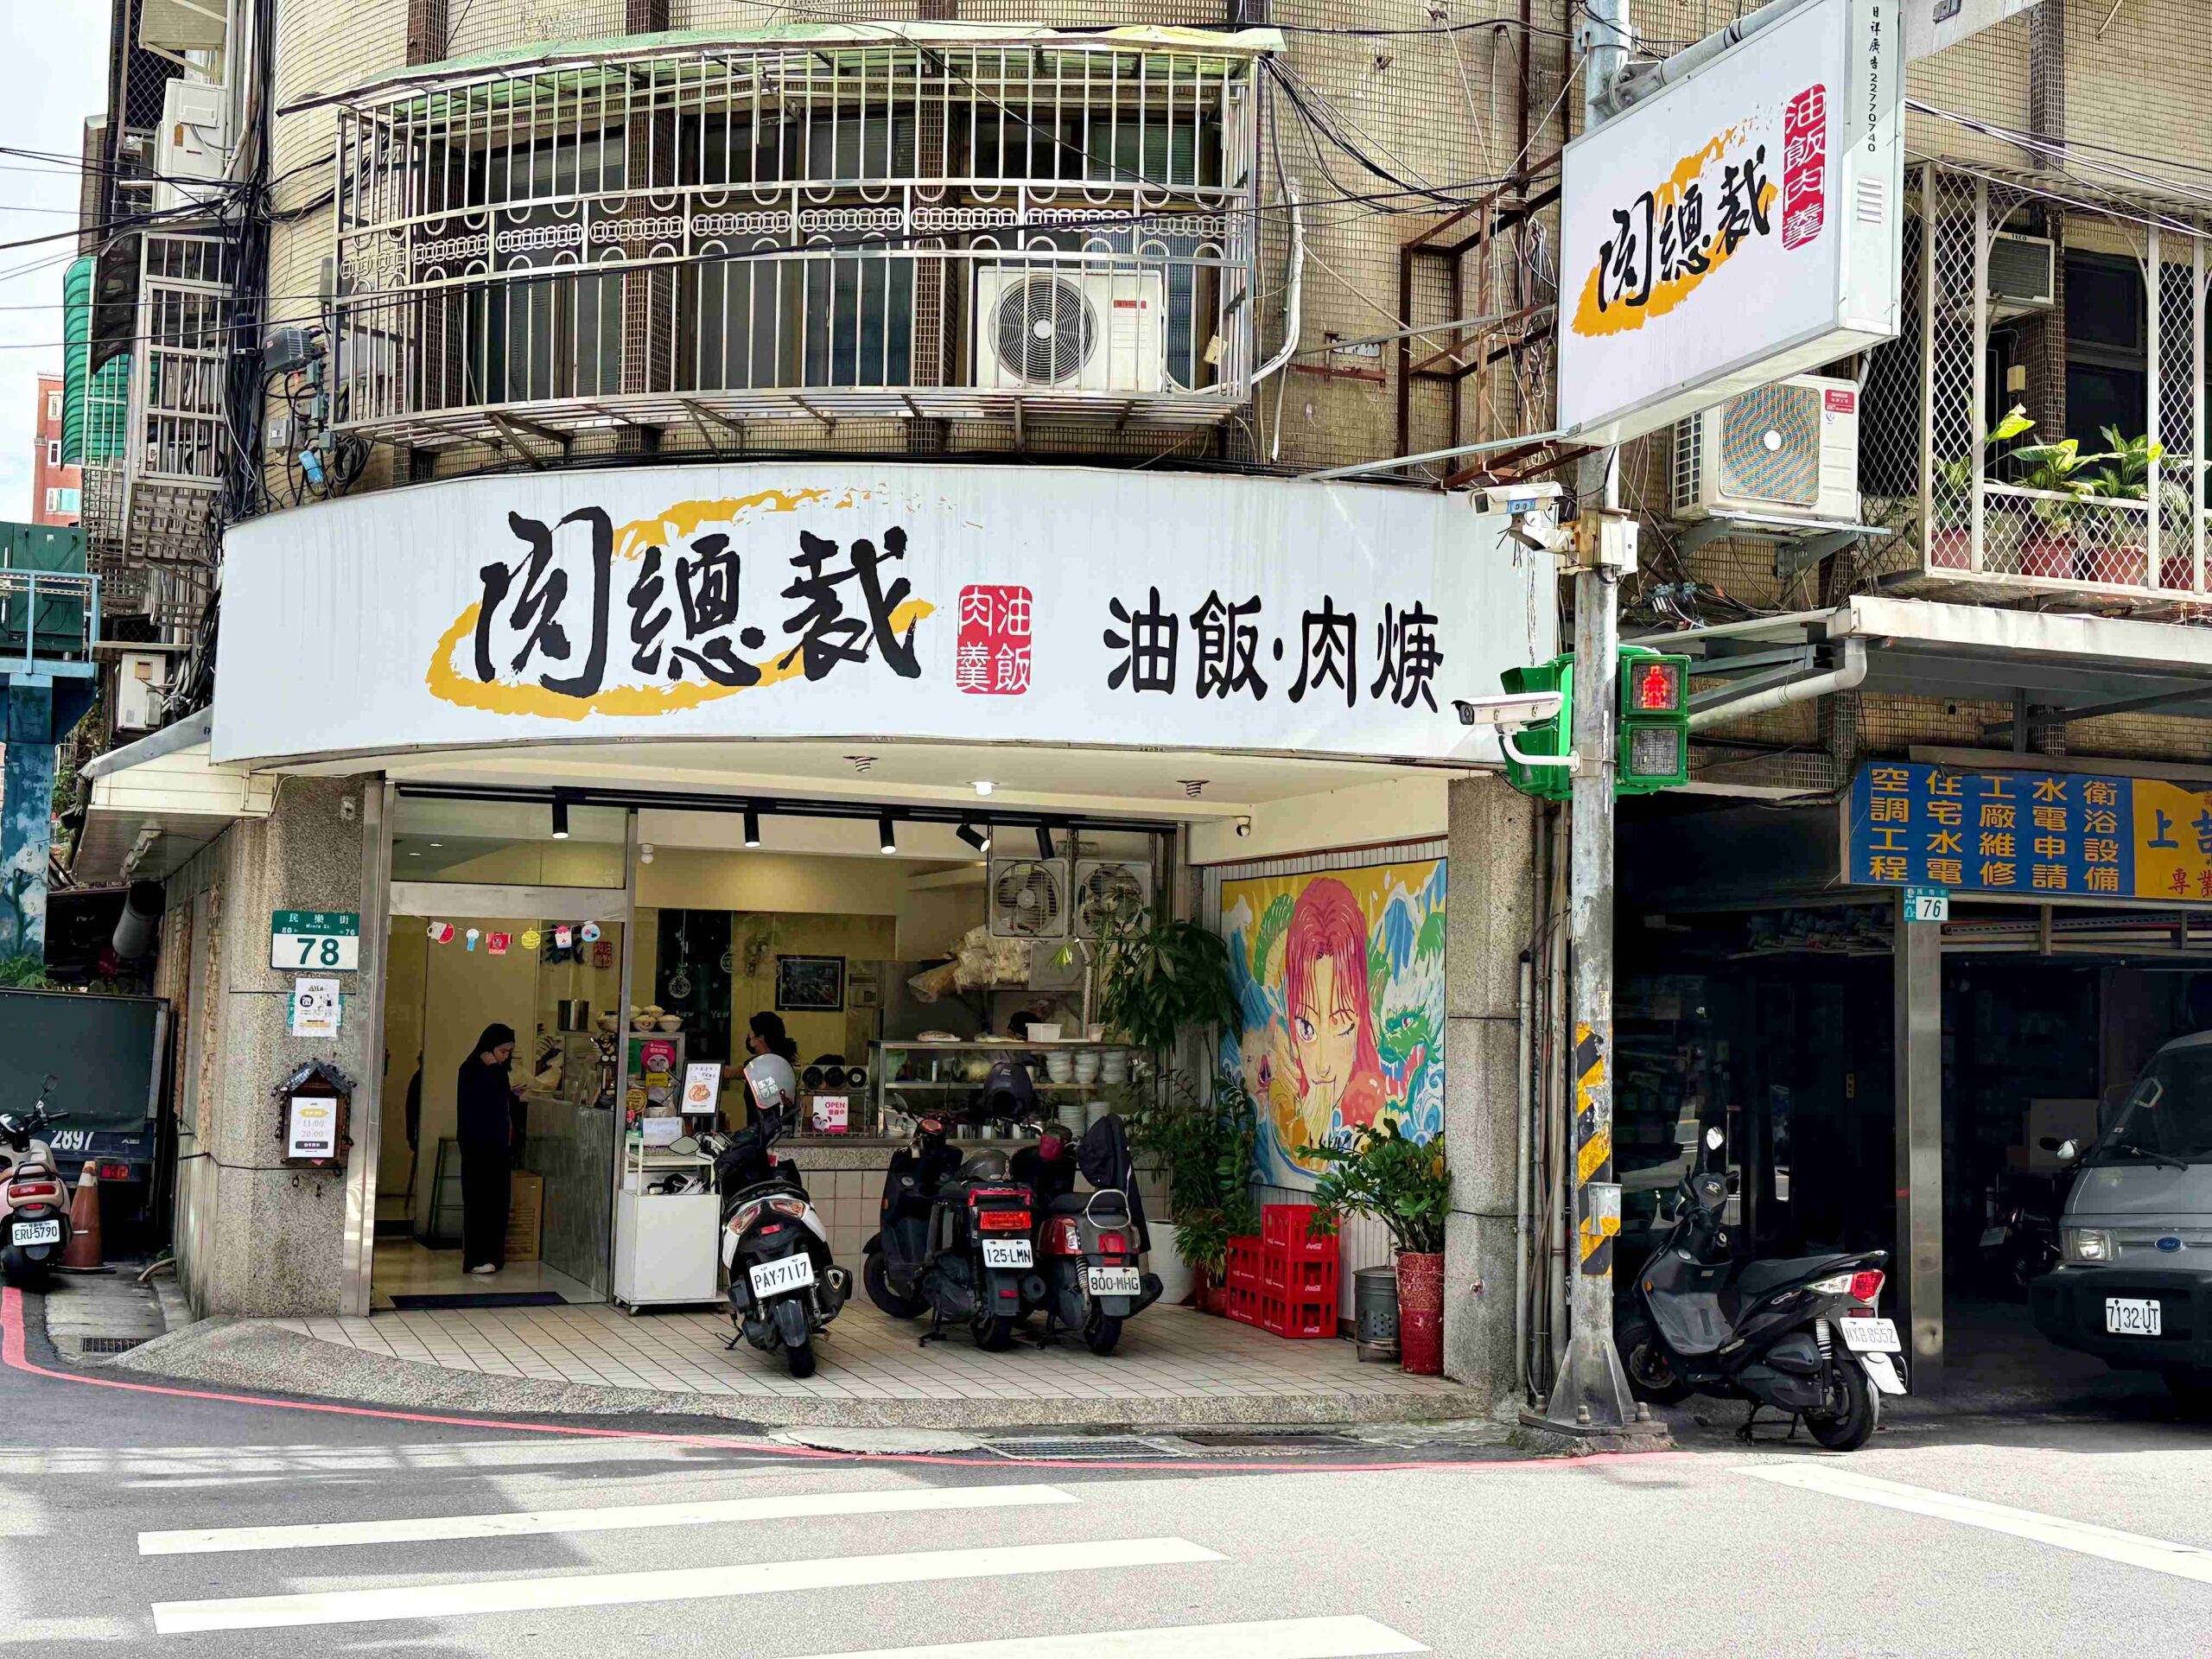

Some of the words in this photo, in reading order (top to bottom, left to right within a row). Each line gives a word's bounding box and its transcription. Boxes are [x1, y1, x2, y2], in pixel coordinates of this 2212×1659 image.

[1869, 767, 1910, 881] 空調工程
[1926, 770, 1963, 885] 住宅水電
[1980, 775, 2017, 886] 工廠維修
[2032, 778, 2068, 890] 水電申請
[2083, 780, 2120, 892] 衛浴設備
[1923, 899, 1942, 918] 76
[297, 938, 340, 966] 78
[15, 1226, 57, 1241] ERU-5790
[987, 1249, 1032, 1263] 125-LMN
[753, 1262, 807, 1290] PAY-7117
[1090, 1277, 1139, 1291] 800-MHG
[2107, 1306, 2158, 1331] 7132-UT
